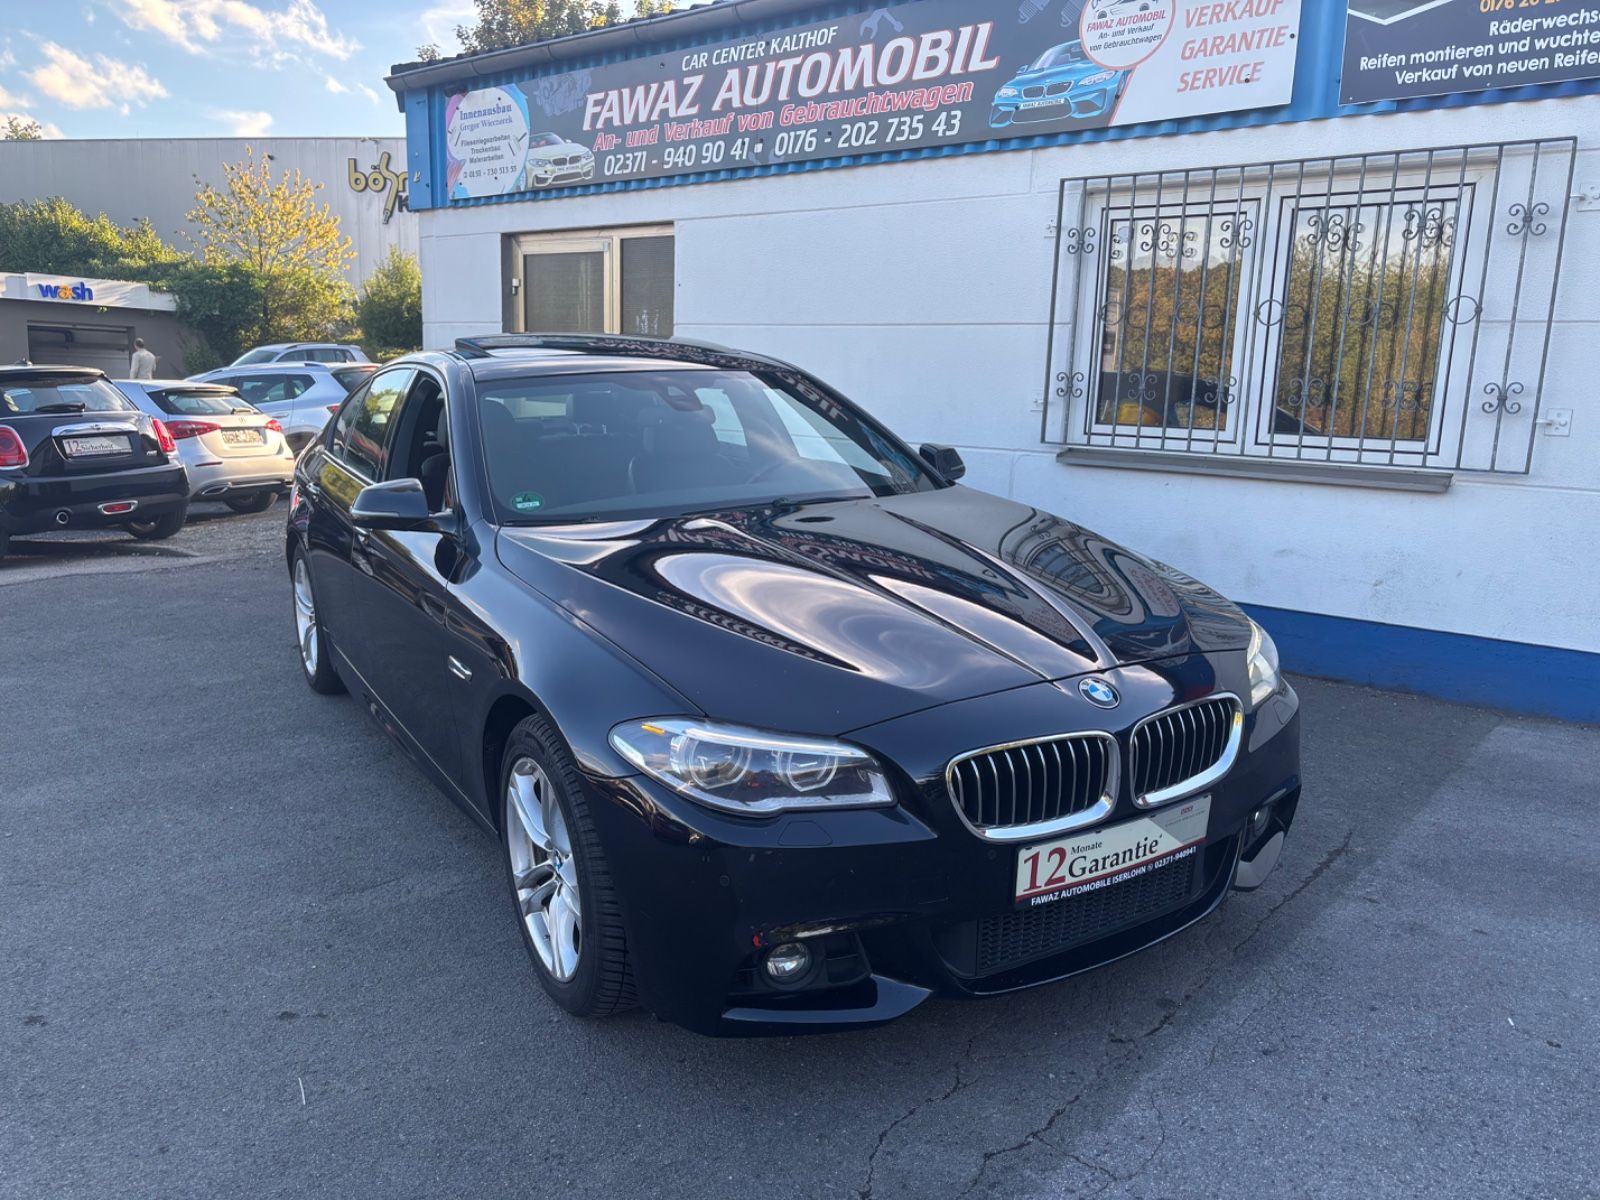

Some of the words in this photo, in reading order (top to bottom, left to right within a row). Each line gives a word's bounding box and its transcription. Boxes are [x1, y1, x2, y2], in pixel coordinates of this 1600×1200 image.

[1087, 19, 1115, 32] FAWAZ
[1116, 10, 1166, 27] AUTOMOBIL
[1112, 29, 1126, 38] und
[1127, 23, 1154, 35] Verkauf
[1185, 0, 1284, 28] VERKAUF
[1489, 9, 1600, 36] Räderwechs
[682, 52, 708, 71] CAR
[712, 41, 766, 66] CENTER
[770, 26, 839, 55] KALTHOF
[1103, 34, 1163, 49] Gebrauchtwagen
[1180, 25, 1289, 60] GARANTIE
[1360, 53, 1406, 71] Reifen
[1410, 45, 1494, 64] montieren
[1498, 37, 1531, 55] und
[582, 74, 704, 131] FAWAZ
[711, 21, 1000, 112] AUTOMOBIL
[1177, 61, 1264, 93] SERVICE
[1395, 67, 1458, 84] Verkauf
[1463, 63, 1493, 78] von
[1497, 56, 1549, 74] neuen
[1554, 49, 1600, 68] Reife
[592, 132, 622, 151] An-
[625, 124, 660, 147] und
[664, 111, 734, 142] Verkauf
[737, 110, 774, 132] von
[779, 81, 975, 127] Gebrauchtwagen
[604, 150, 647, 176] 02371
[663, 144, 697, 169] 940
[701, 140, 726, 164] 90
[730, 138, 750, 161] 41
[774, 128, 818, 156] 0176
[838, 120, 879, 148] 202
[885, 114, 924, 143] 735
[931, 110, 962, 137] 43
[38, 282, 93, 301] wash
[65, 440, 81, 452] 12
[1070, 840, 1103, 856] Monate
[1023, 847, 1067, 892] 12
[1031, 893, 1060, 906] FAWAZ
[1061, 877, 1112, 899] AUTOMOBILE
[1112, 867, 1147, 884] ISERLOHN
